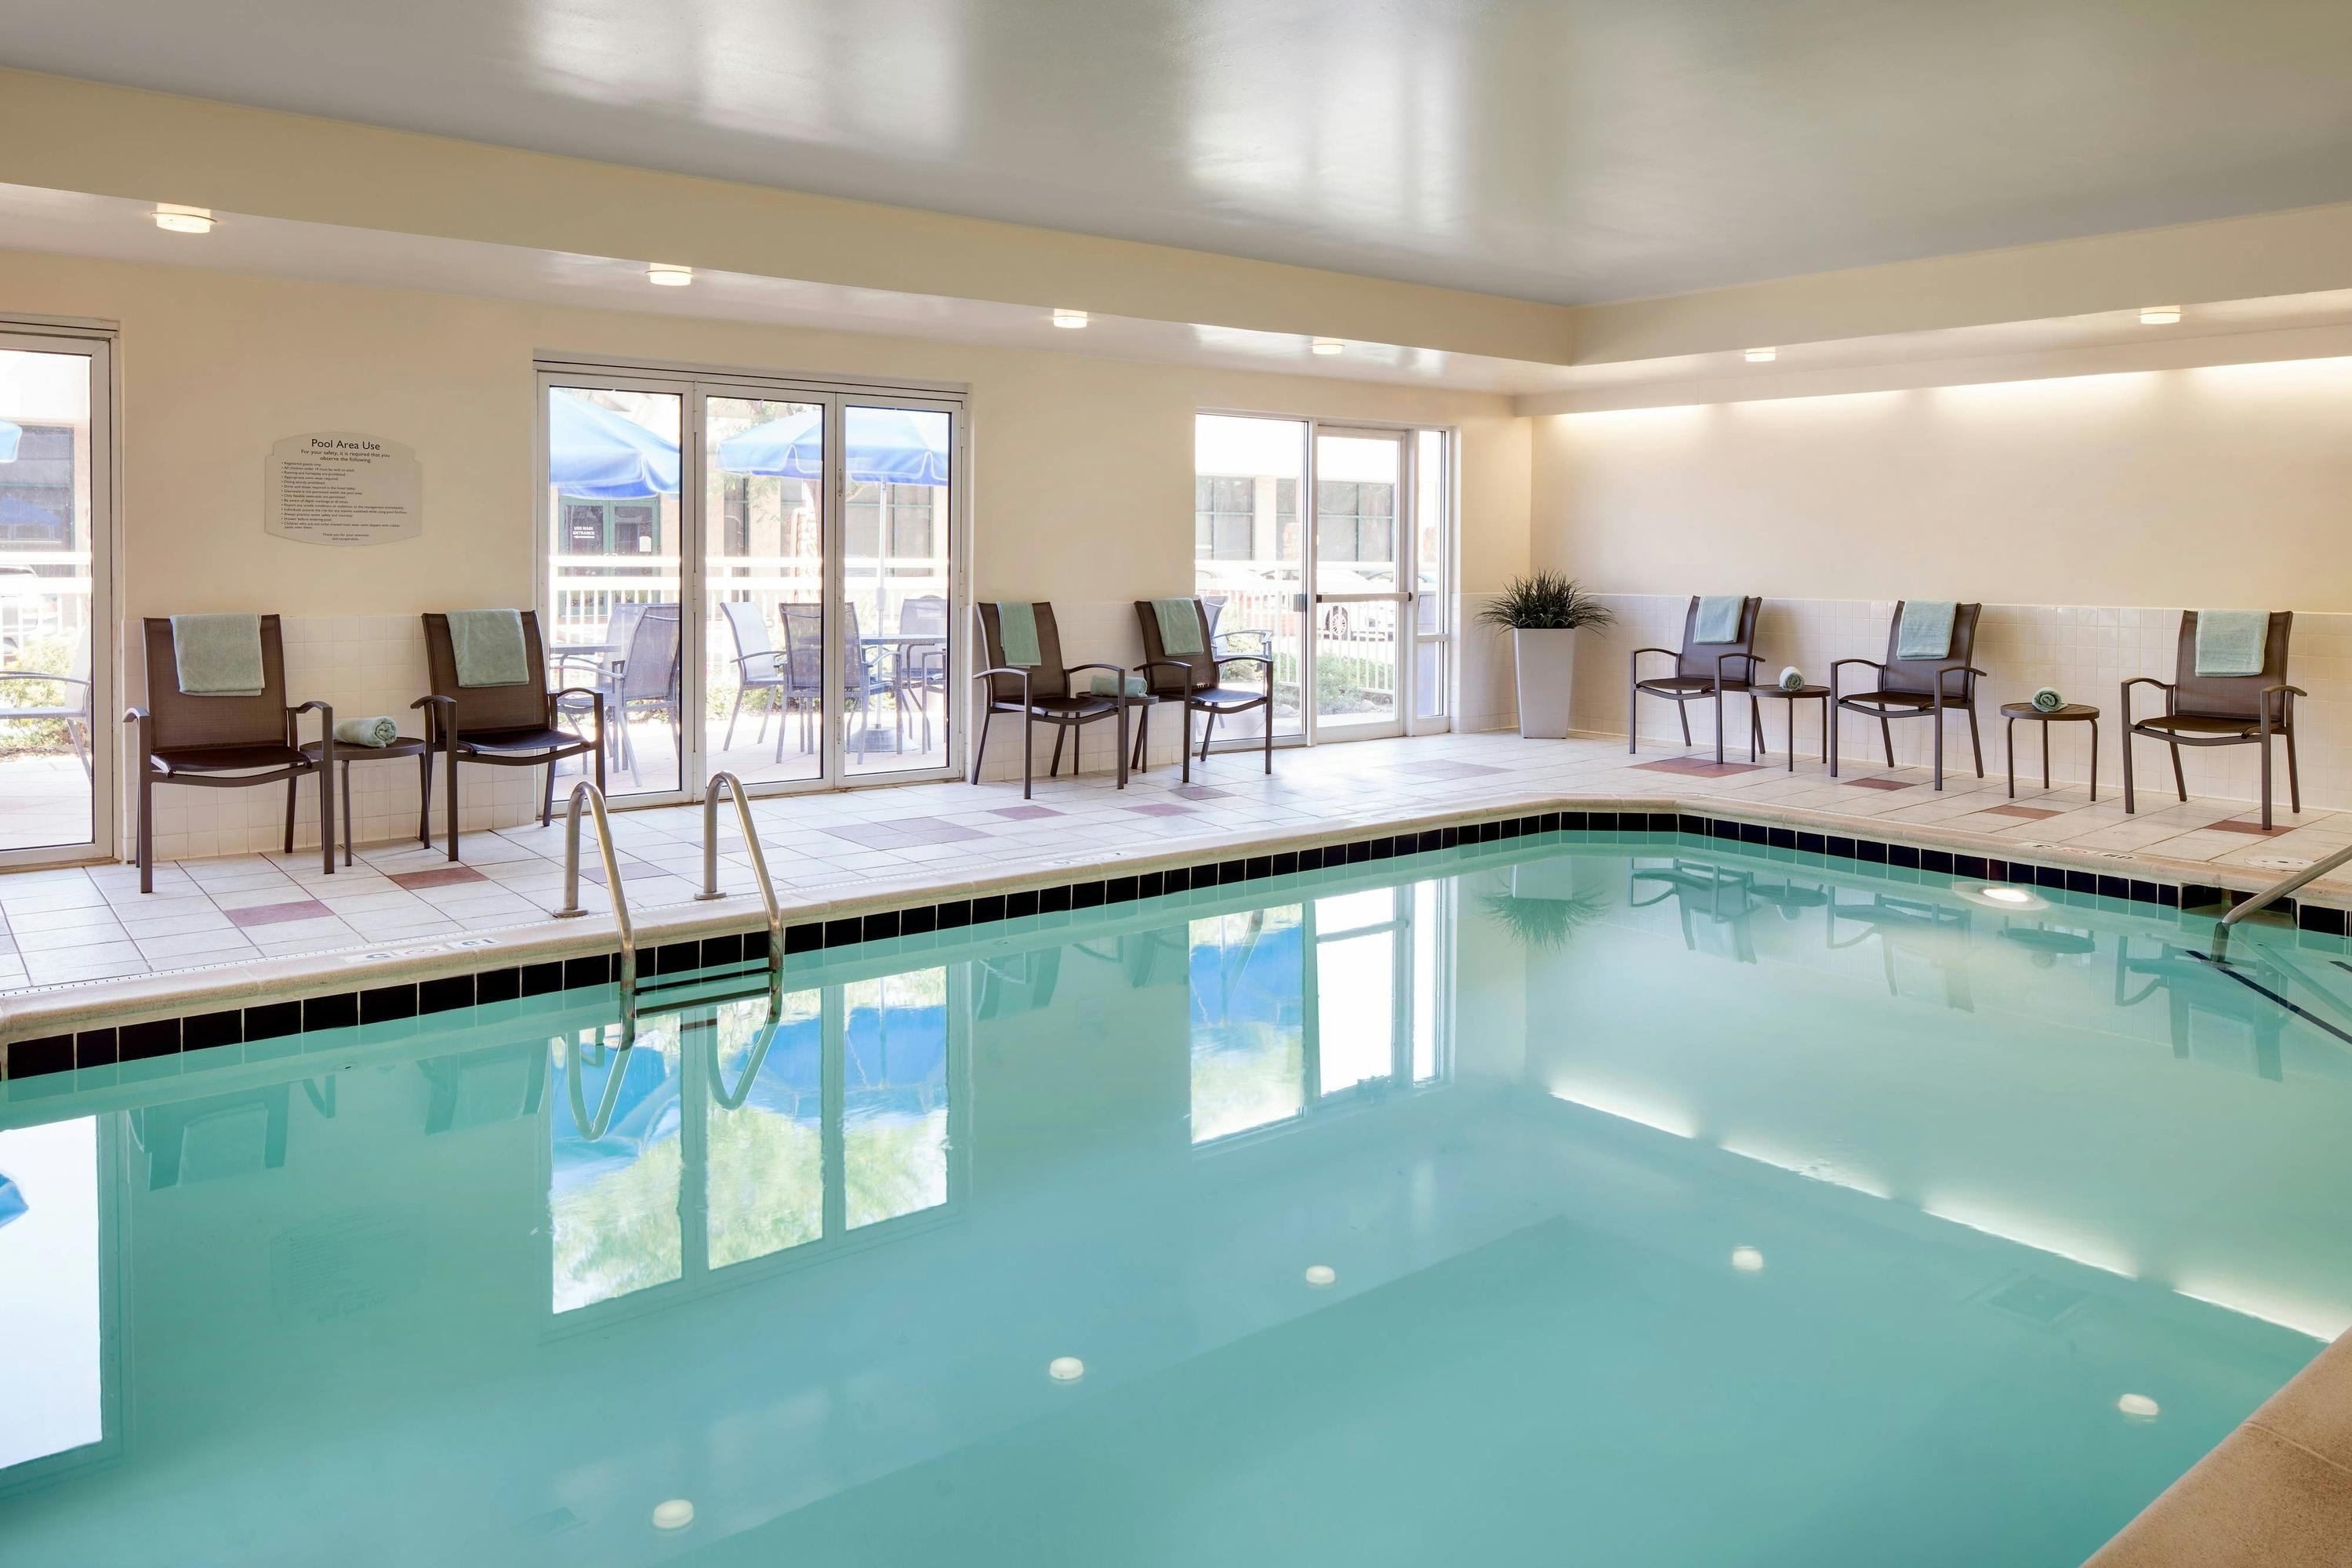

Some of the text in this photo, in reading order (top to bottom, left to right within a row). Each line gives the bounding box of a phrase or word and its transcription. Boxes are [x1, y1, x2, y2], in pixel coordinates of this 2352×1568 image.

[311, 438, 380, 451] Pool Area Use
